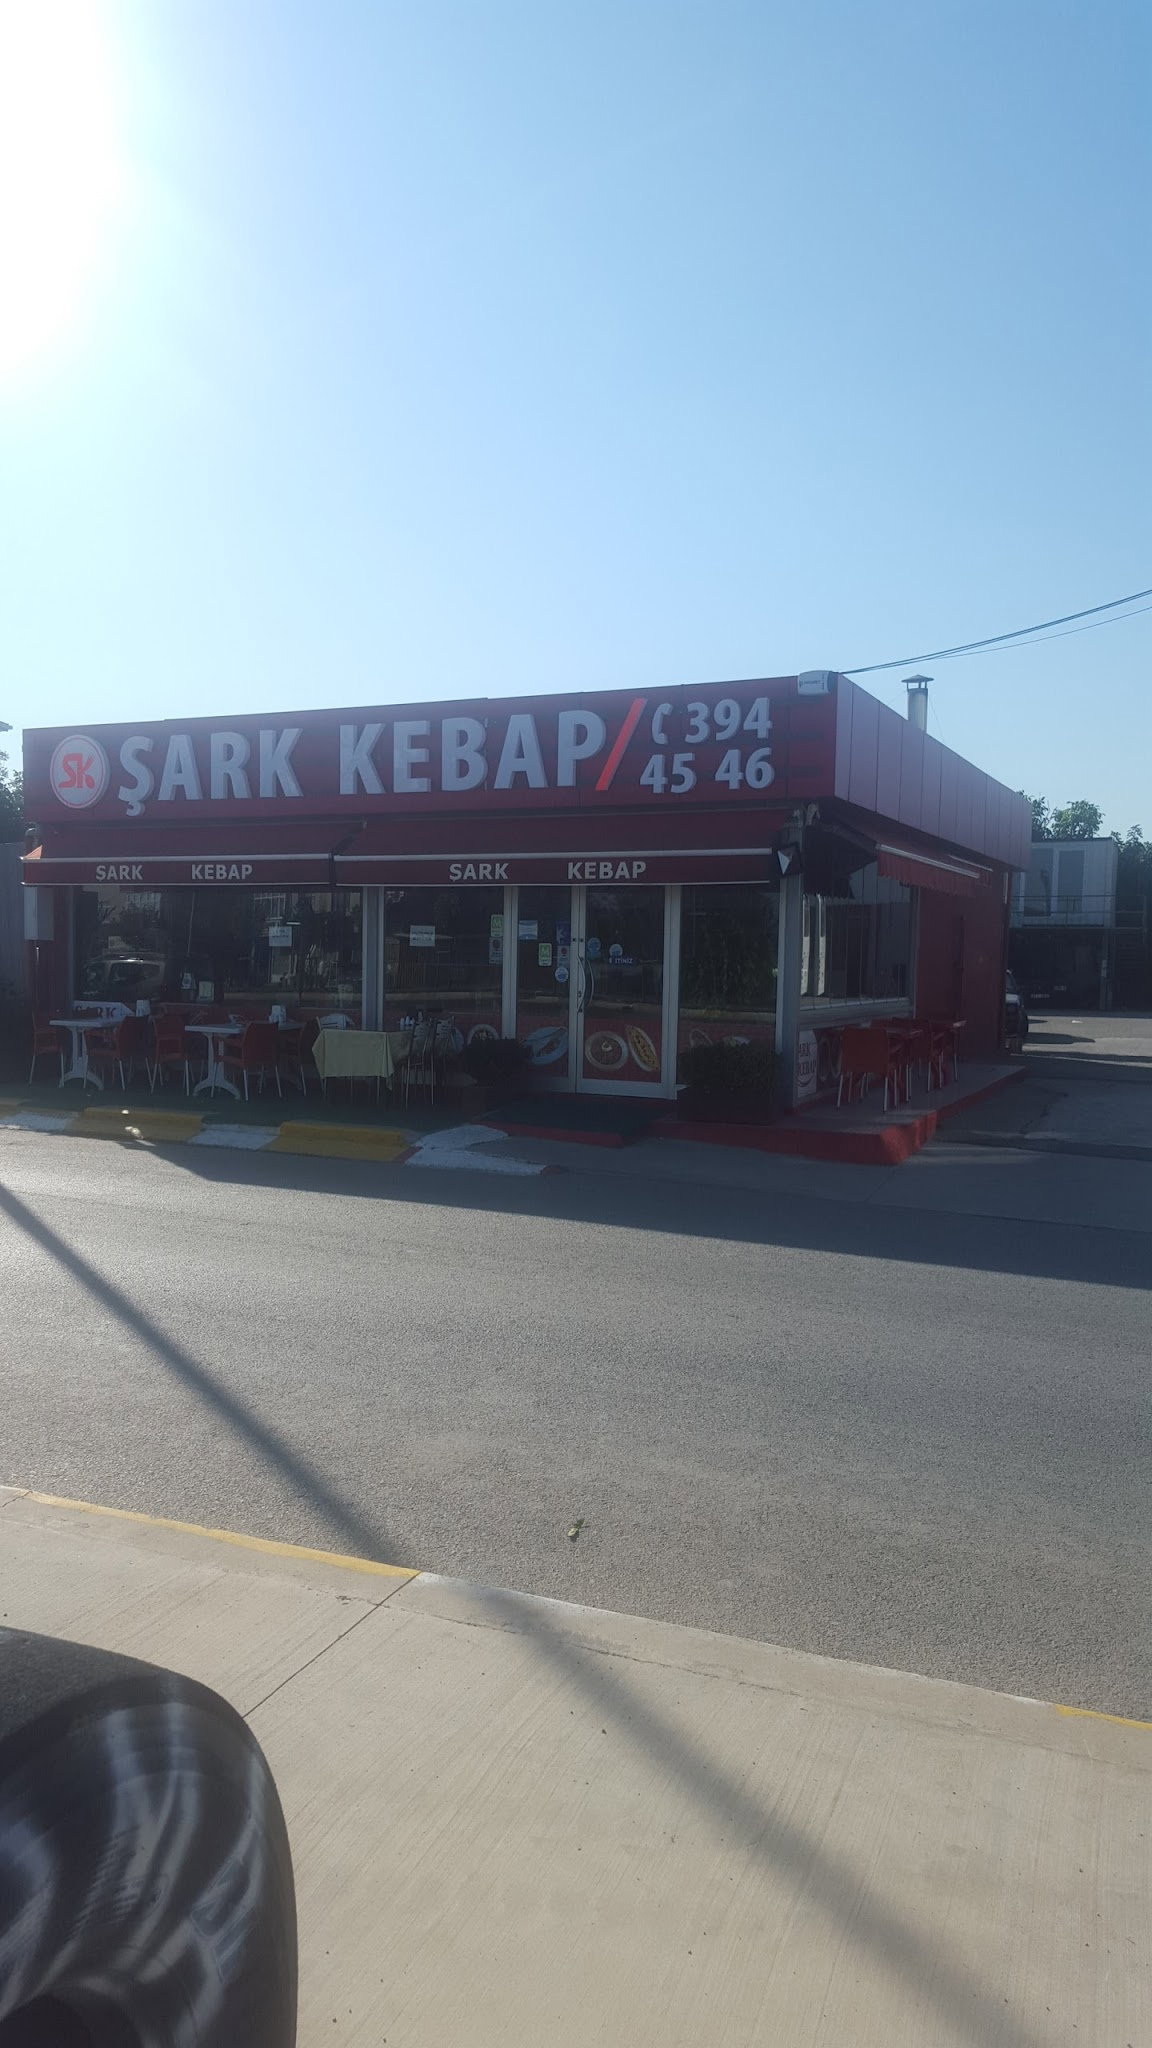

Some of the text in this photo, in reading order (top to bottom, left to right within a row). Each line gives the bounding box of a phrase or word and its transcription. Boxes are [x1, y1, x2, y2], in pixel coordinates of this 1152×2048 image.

[685, 697, 772, 743] 394
[118, 710, 606, 816] ŞARK KEBAP
[639, 747, 775, 793] 45 46
[191, 864, 253, 880] KEBAP
[449, 861, 647, 882] ŞARK KEBAP
